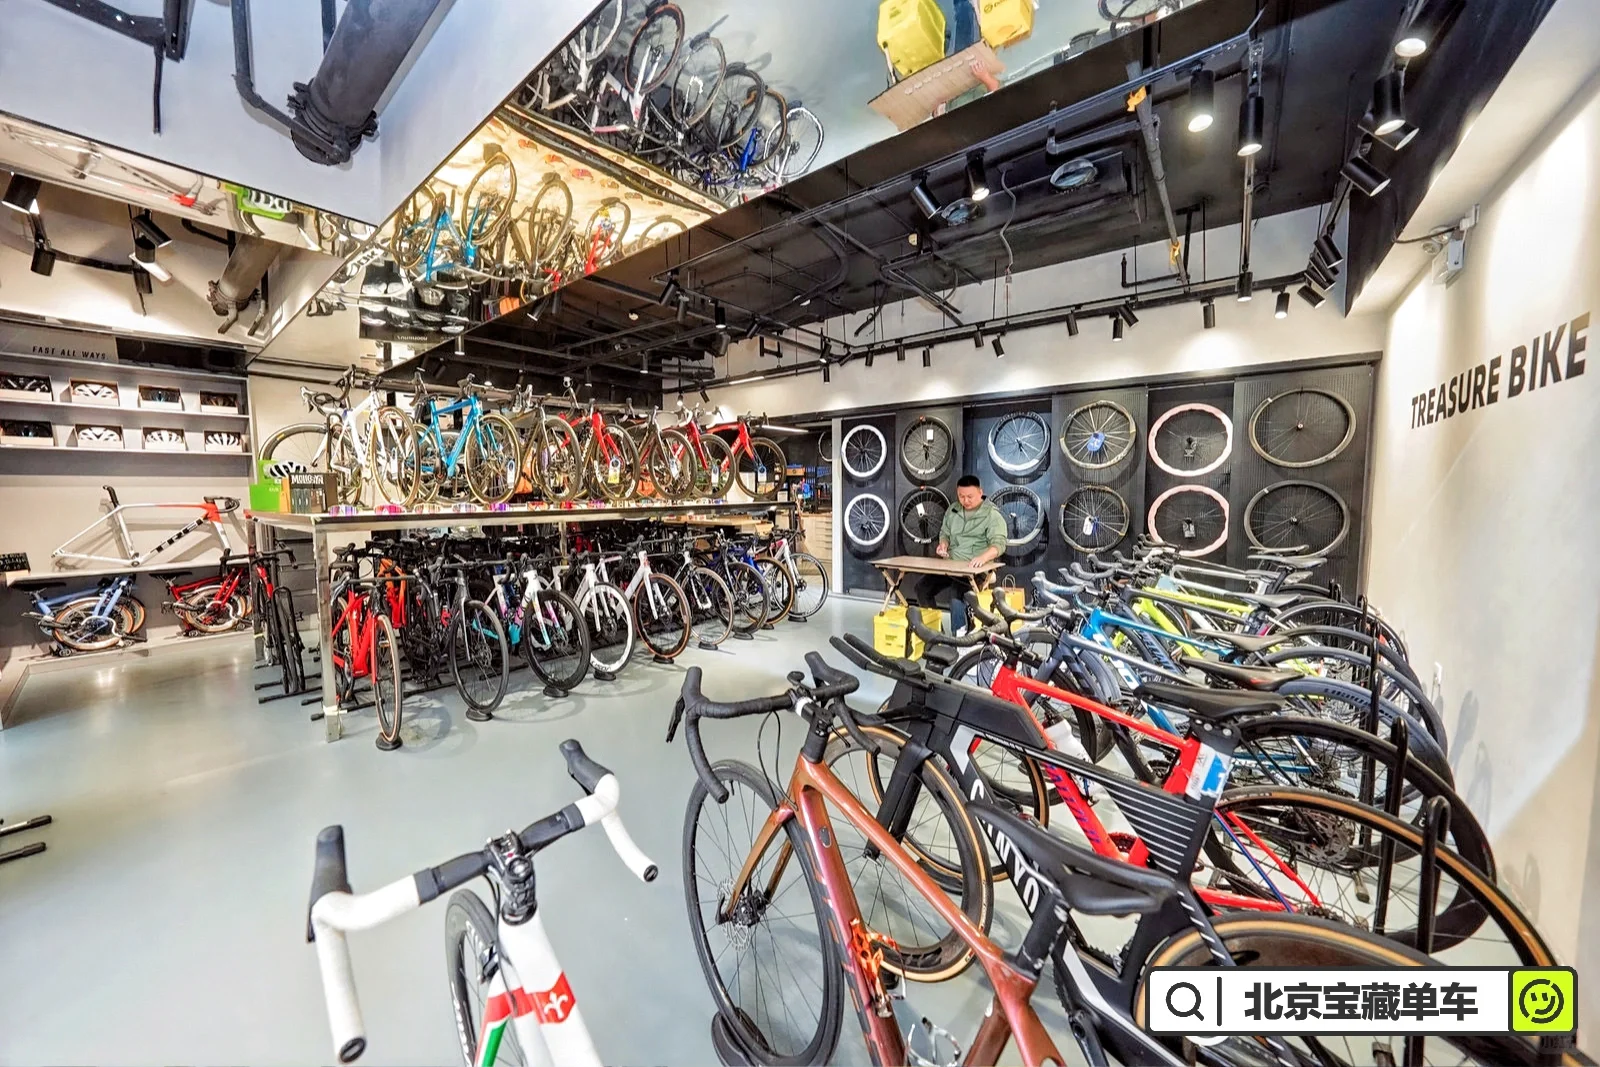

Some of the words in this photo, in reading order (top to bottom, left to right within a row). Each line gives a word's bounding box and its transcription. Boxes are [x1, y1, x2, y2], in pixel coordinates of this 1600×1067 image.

[32, 345, 56, 355] FAST
[60, 348, 77, 357] ALL
[1411, 355, 1502, 430] TREASURE
[1507, 311, 1591, 399] BIKE
